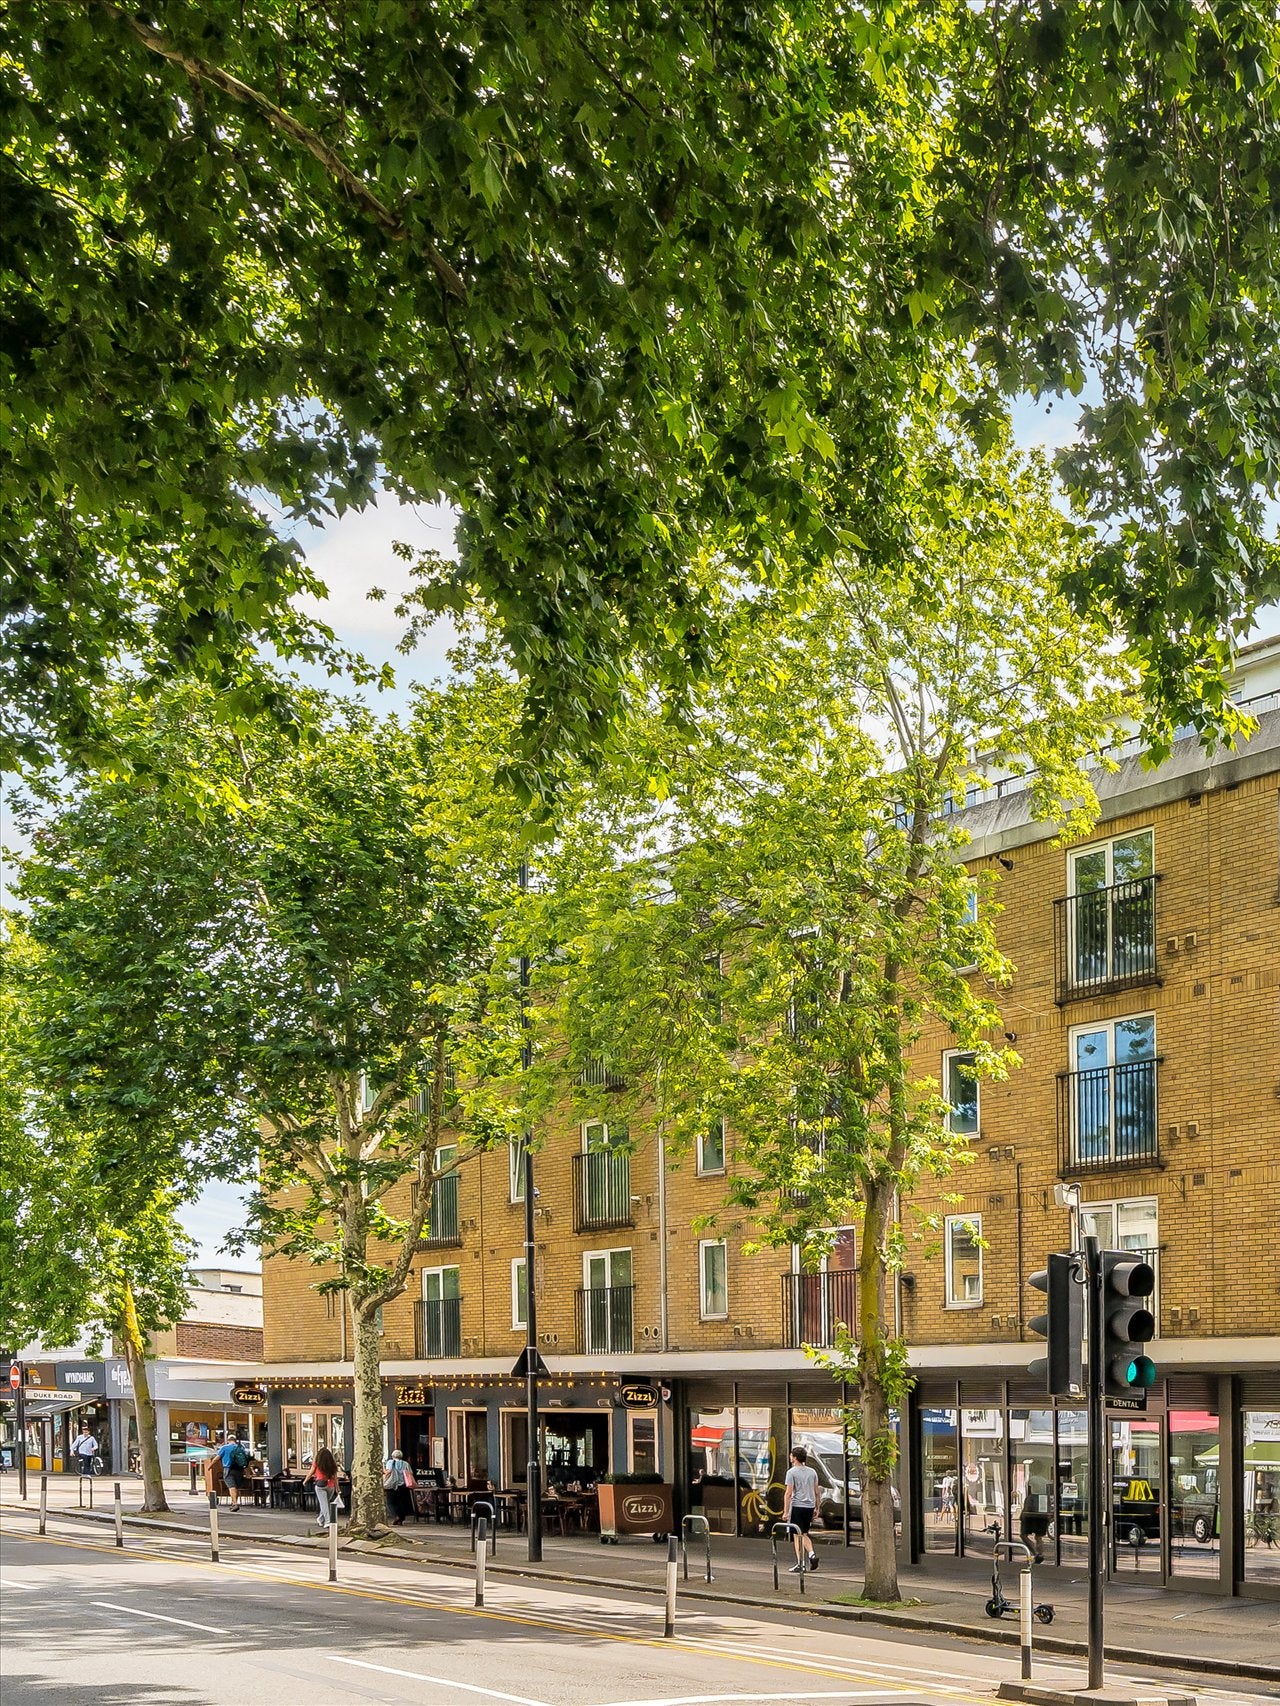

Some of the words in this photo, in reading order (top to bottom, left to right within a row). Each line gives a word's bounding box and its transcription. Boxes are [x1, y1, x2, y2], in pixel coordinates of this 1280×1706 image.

[65, 1372, 94, 1384] WYNDHAMS
[238, 1392, 262, 1401] Zizzi
[626, 1391, 652, 1402] Zizzi
[1113, 1399, 1139, 1409] DENTAL
[415, 1468, 436, 1476] Zizzi
[629, 1503, 657, 1514] Zizzi
